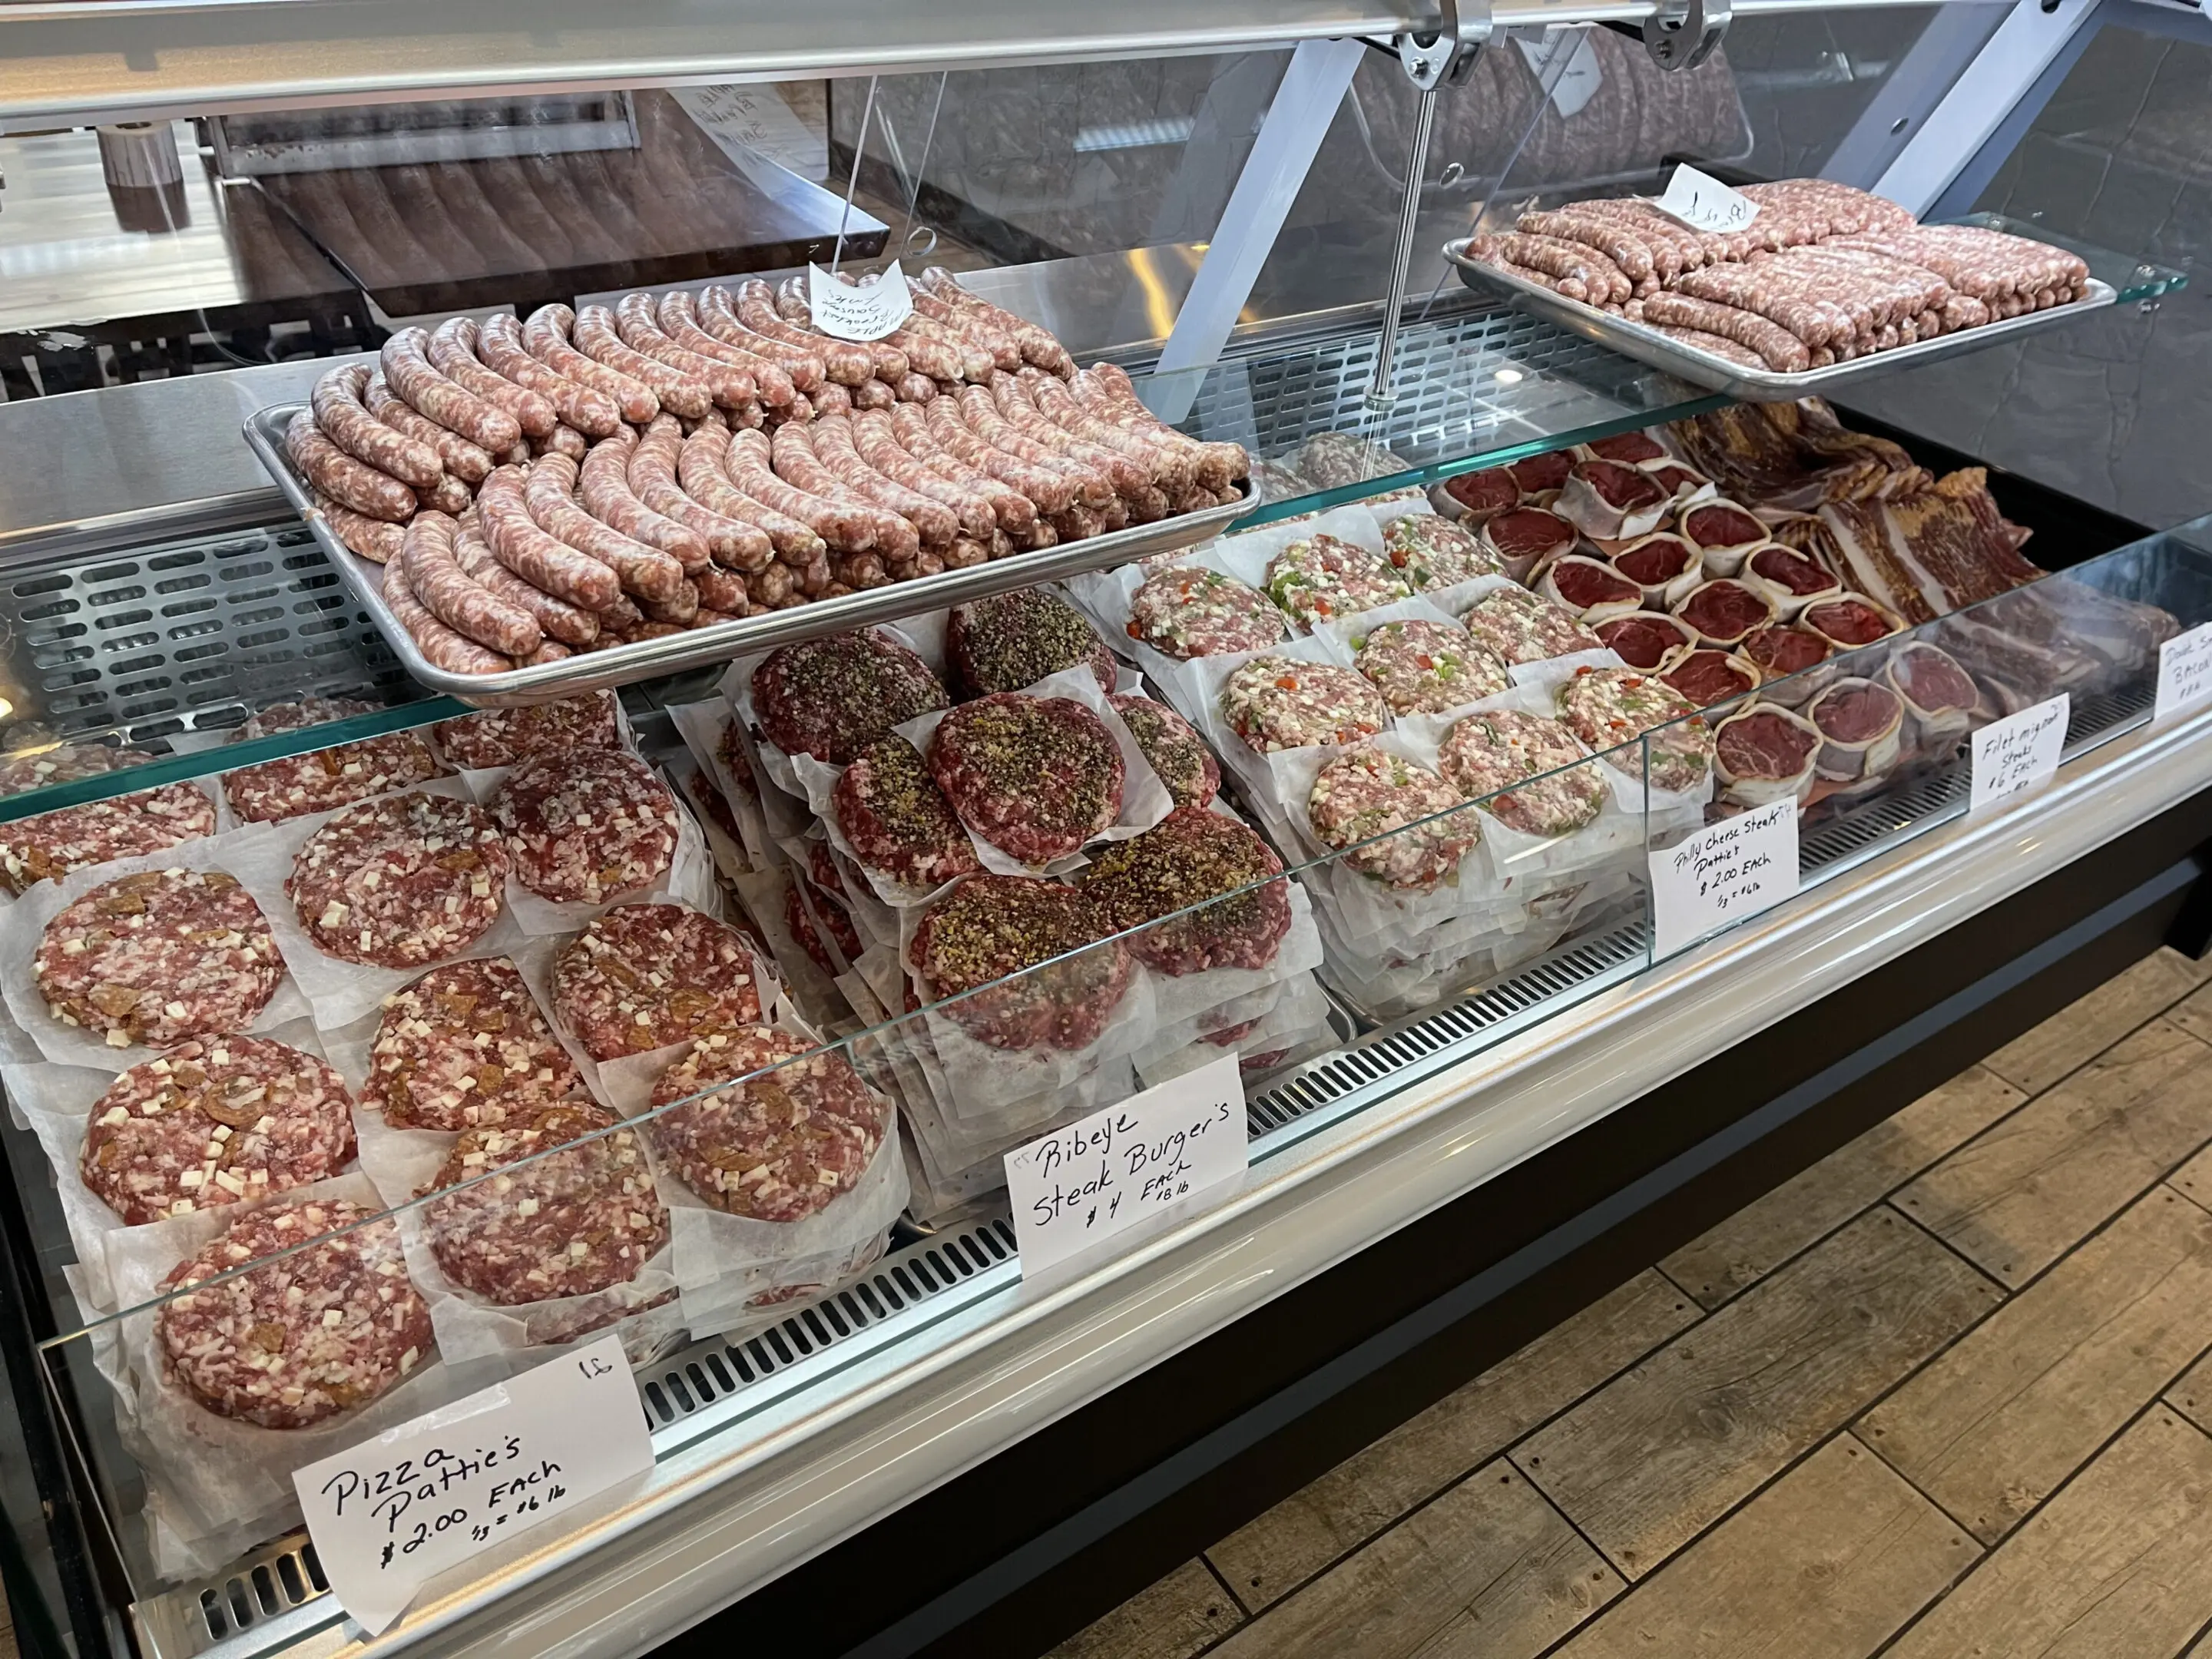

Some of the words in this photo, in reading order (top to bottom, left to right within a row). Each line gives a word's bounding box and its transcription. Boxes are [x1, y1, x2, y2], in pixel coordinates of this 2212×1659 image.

[1033, 1160, 1114, 1226] Steak
[1124, 1102, 1229, 1175] Burger's
[1035, 1114, 1138, 1178] Ribeye
[321, 1449, 455, 1516] Pizza
